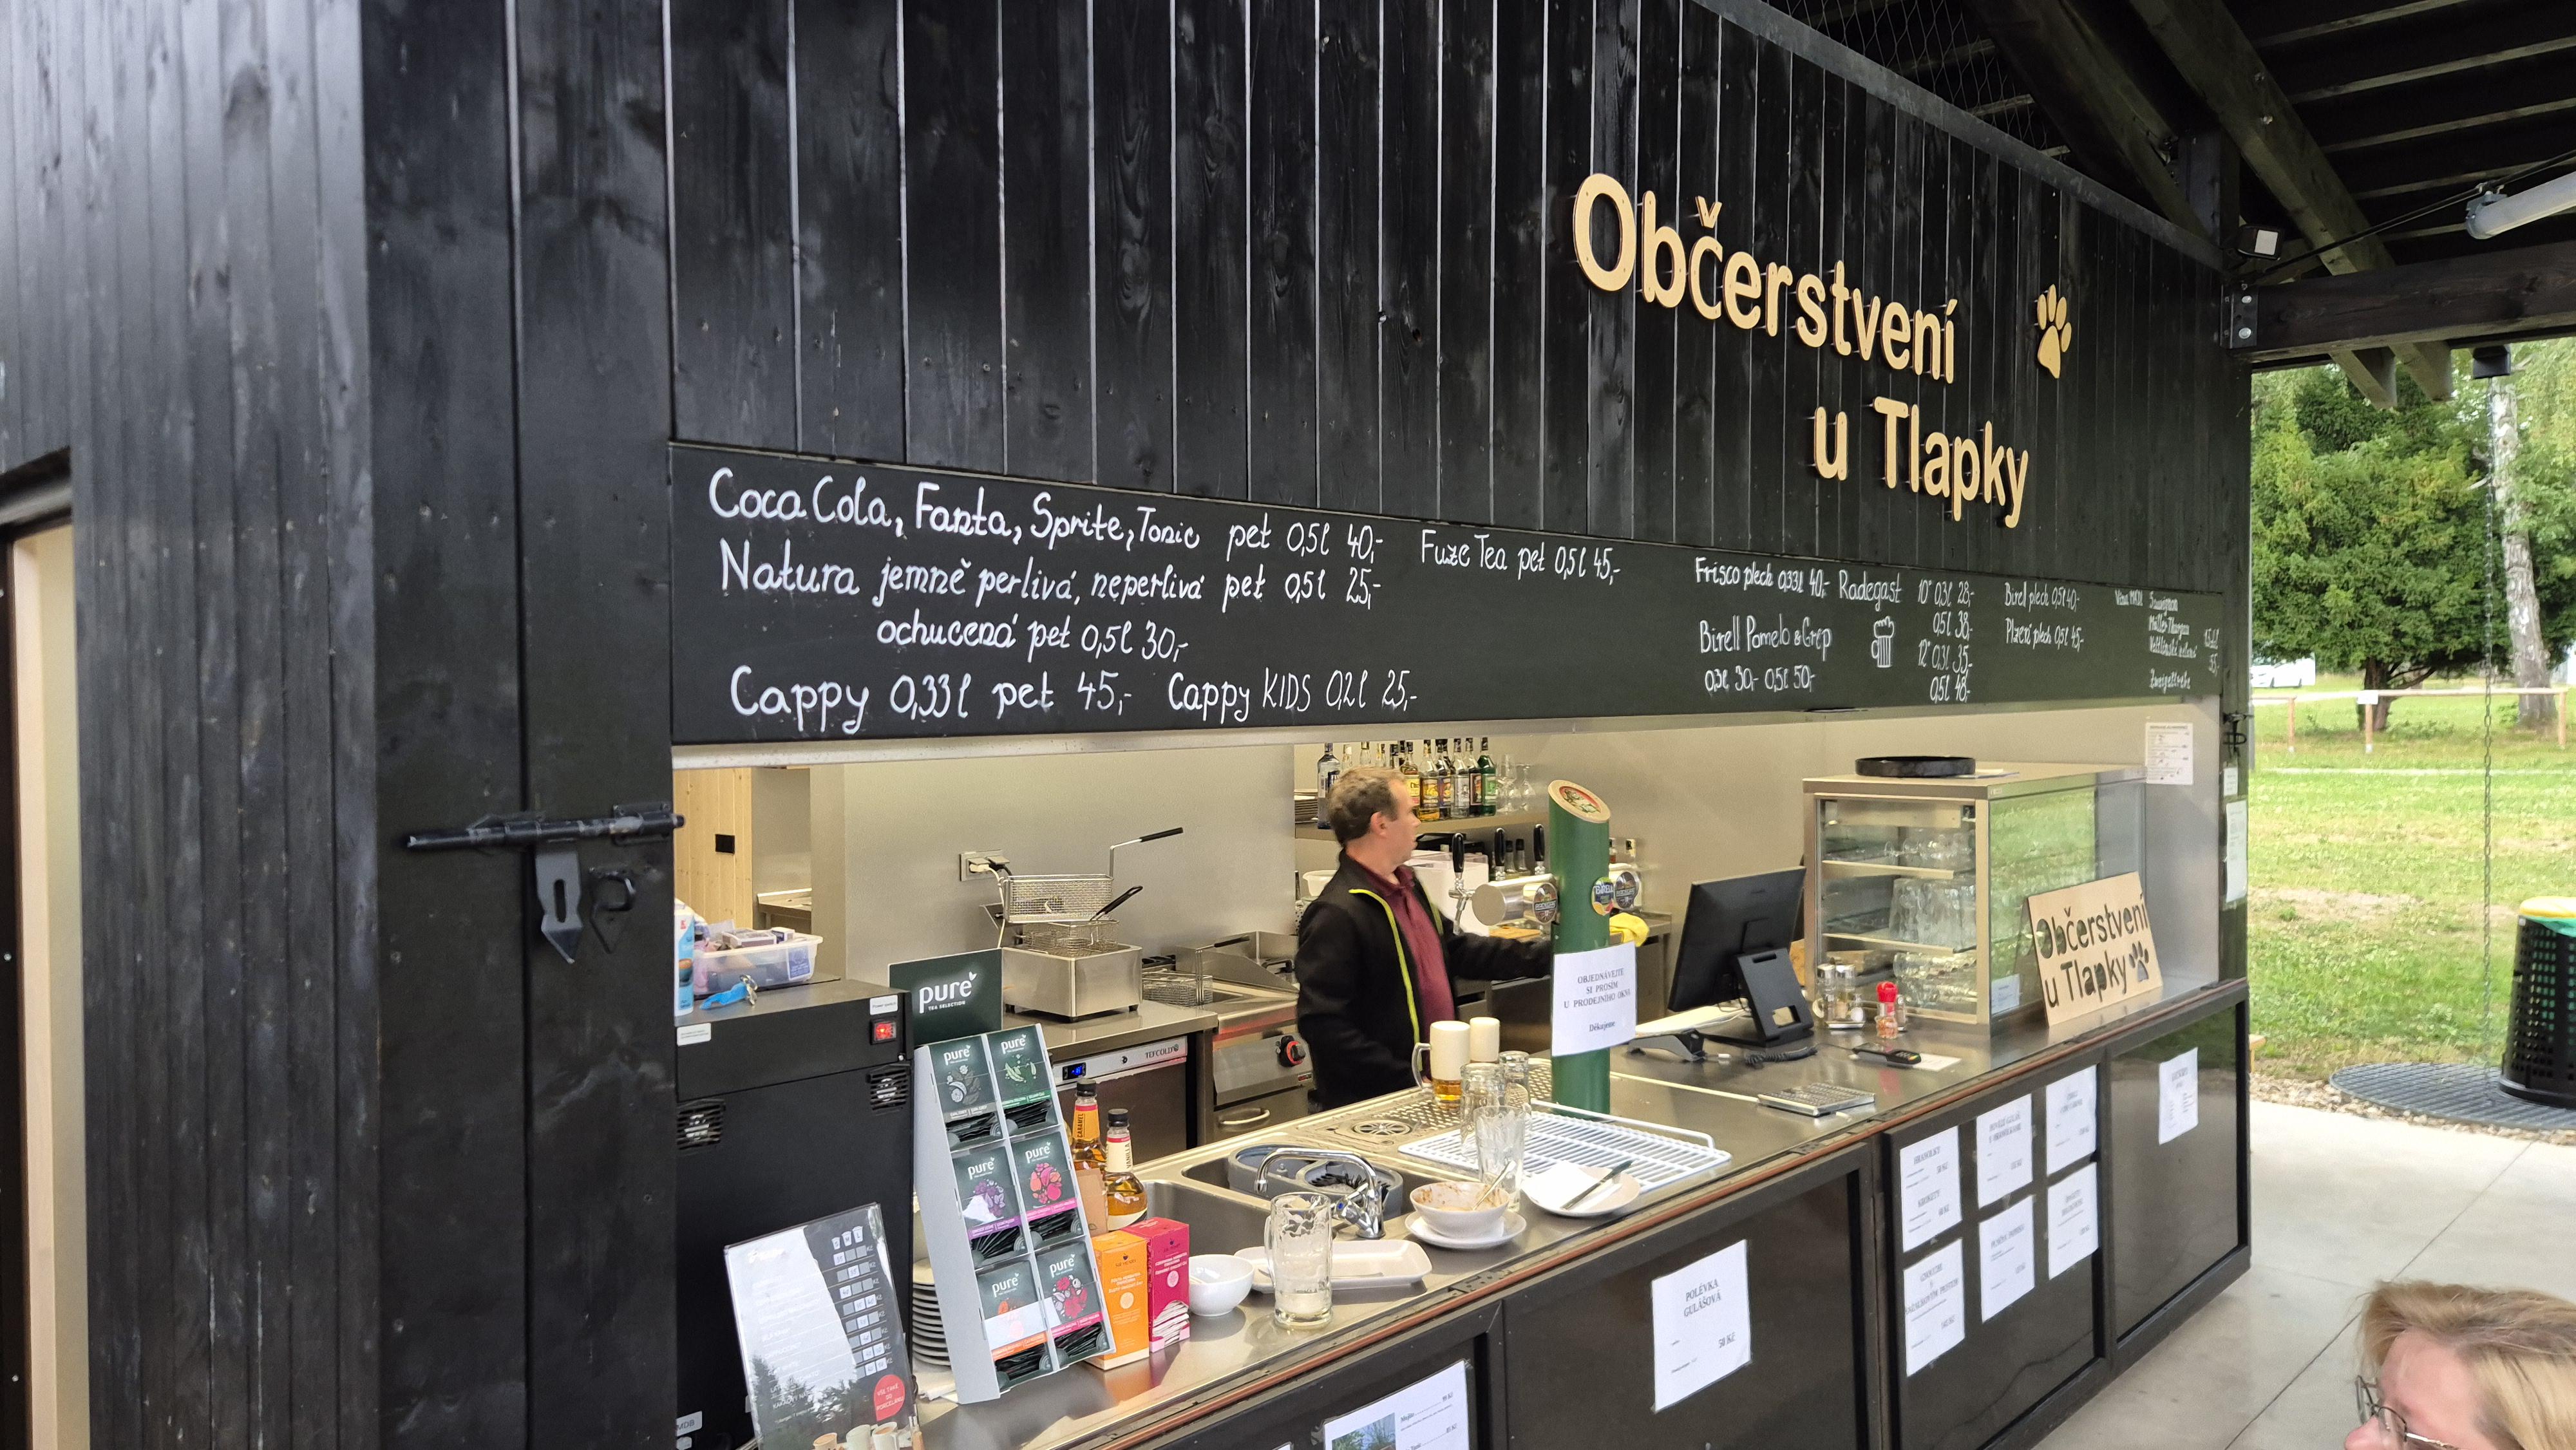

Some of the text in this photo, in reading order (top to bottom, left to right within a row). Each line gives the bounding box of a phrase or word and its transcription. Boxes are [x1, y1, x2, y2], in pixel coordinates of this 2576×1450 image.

[1573, 173, 1958, 384] Občerstvení
[1814, 396, 2029, 529] u Tlapky
[916, 482, 1022, 545] Fanta,
[1226, 512, 1272, 562] pet
[1347, 523, 1383, 564] 40,-
[1421, 529, 1470, 567] Fuze
[1473, 534, 1508, 570] Tea
[1517, 541, 1545, 581] pet
[1593, 547, 1621, 585] 45,-
[1695, 556, 1740, 586] Frisco
[1743, 561, 1774, 591] plech
[719, 538, 860, 596] Natura
[871, 556, 972, 607] jemně
[975, 556, 1081, 608] perlivá,
[1090, 564, 1205, 605] neperlivá
[1222, 563, 1266, 613] pet
[1346, 567, 1381, 610] 25,-
[1839, 569, 1902, 612] Radegast
[876, 608, 1019, 648] ochucená
[1027, 615, 1071, 663] pet
[1141, 619, 1189, 663] 30,-
[1700, 615, 1740, 654] Birell
[1747, 613, 1790, 652] Pomelo
[730, 664, 869, 735] Cappy
[991, 670, 1054, 719] pet
[1077, 670, 1132, 716] 45,-
[1168, 672, 1250, 724] Cappy
[1262, 666, 1311, 712] KIDS
[1381, 669, 1417, 711] 25,-
[2036, 892, 2148, 959] Občerstvení
[1578, 968, 1624, 984] OBJEDNÁVEJTE
[1596, 981, 1618, 992] PROSÍM
[2045, 950, 2127, 1008] u Tlapky
[920, 980, 972, 1013] pure
[939, 1001, 966, 1009] SELECTION
[1573, 993, 1616, 1008] PRODEJNÍHO
[1589, 1021, 1615, 1032] Děkujeme
[943, 1048, 970, 1066] pure
[1001, 1037, 1026, 1054] pure
[968, 1160, 994, 1180] pure
[1025, 1144, 1050, 1163] pure
[1049, 1256, 1074, 1277] pure
[991, 1276, 1019, 1298] pure
[1684, 1289, 1721, 1317] GULÁŠOVÁ
[1686, 1279, 1719, 1301] POLÉVKA
